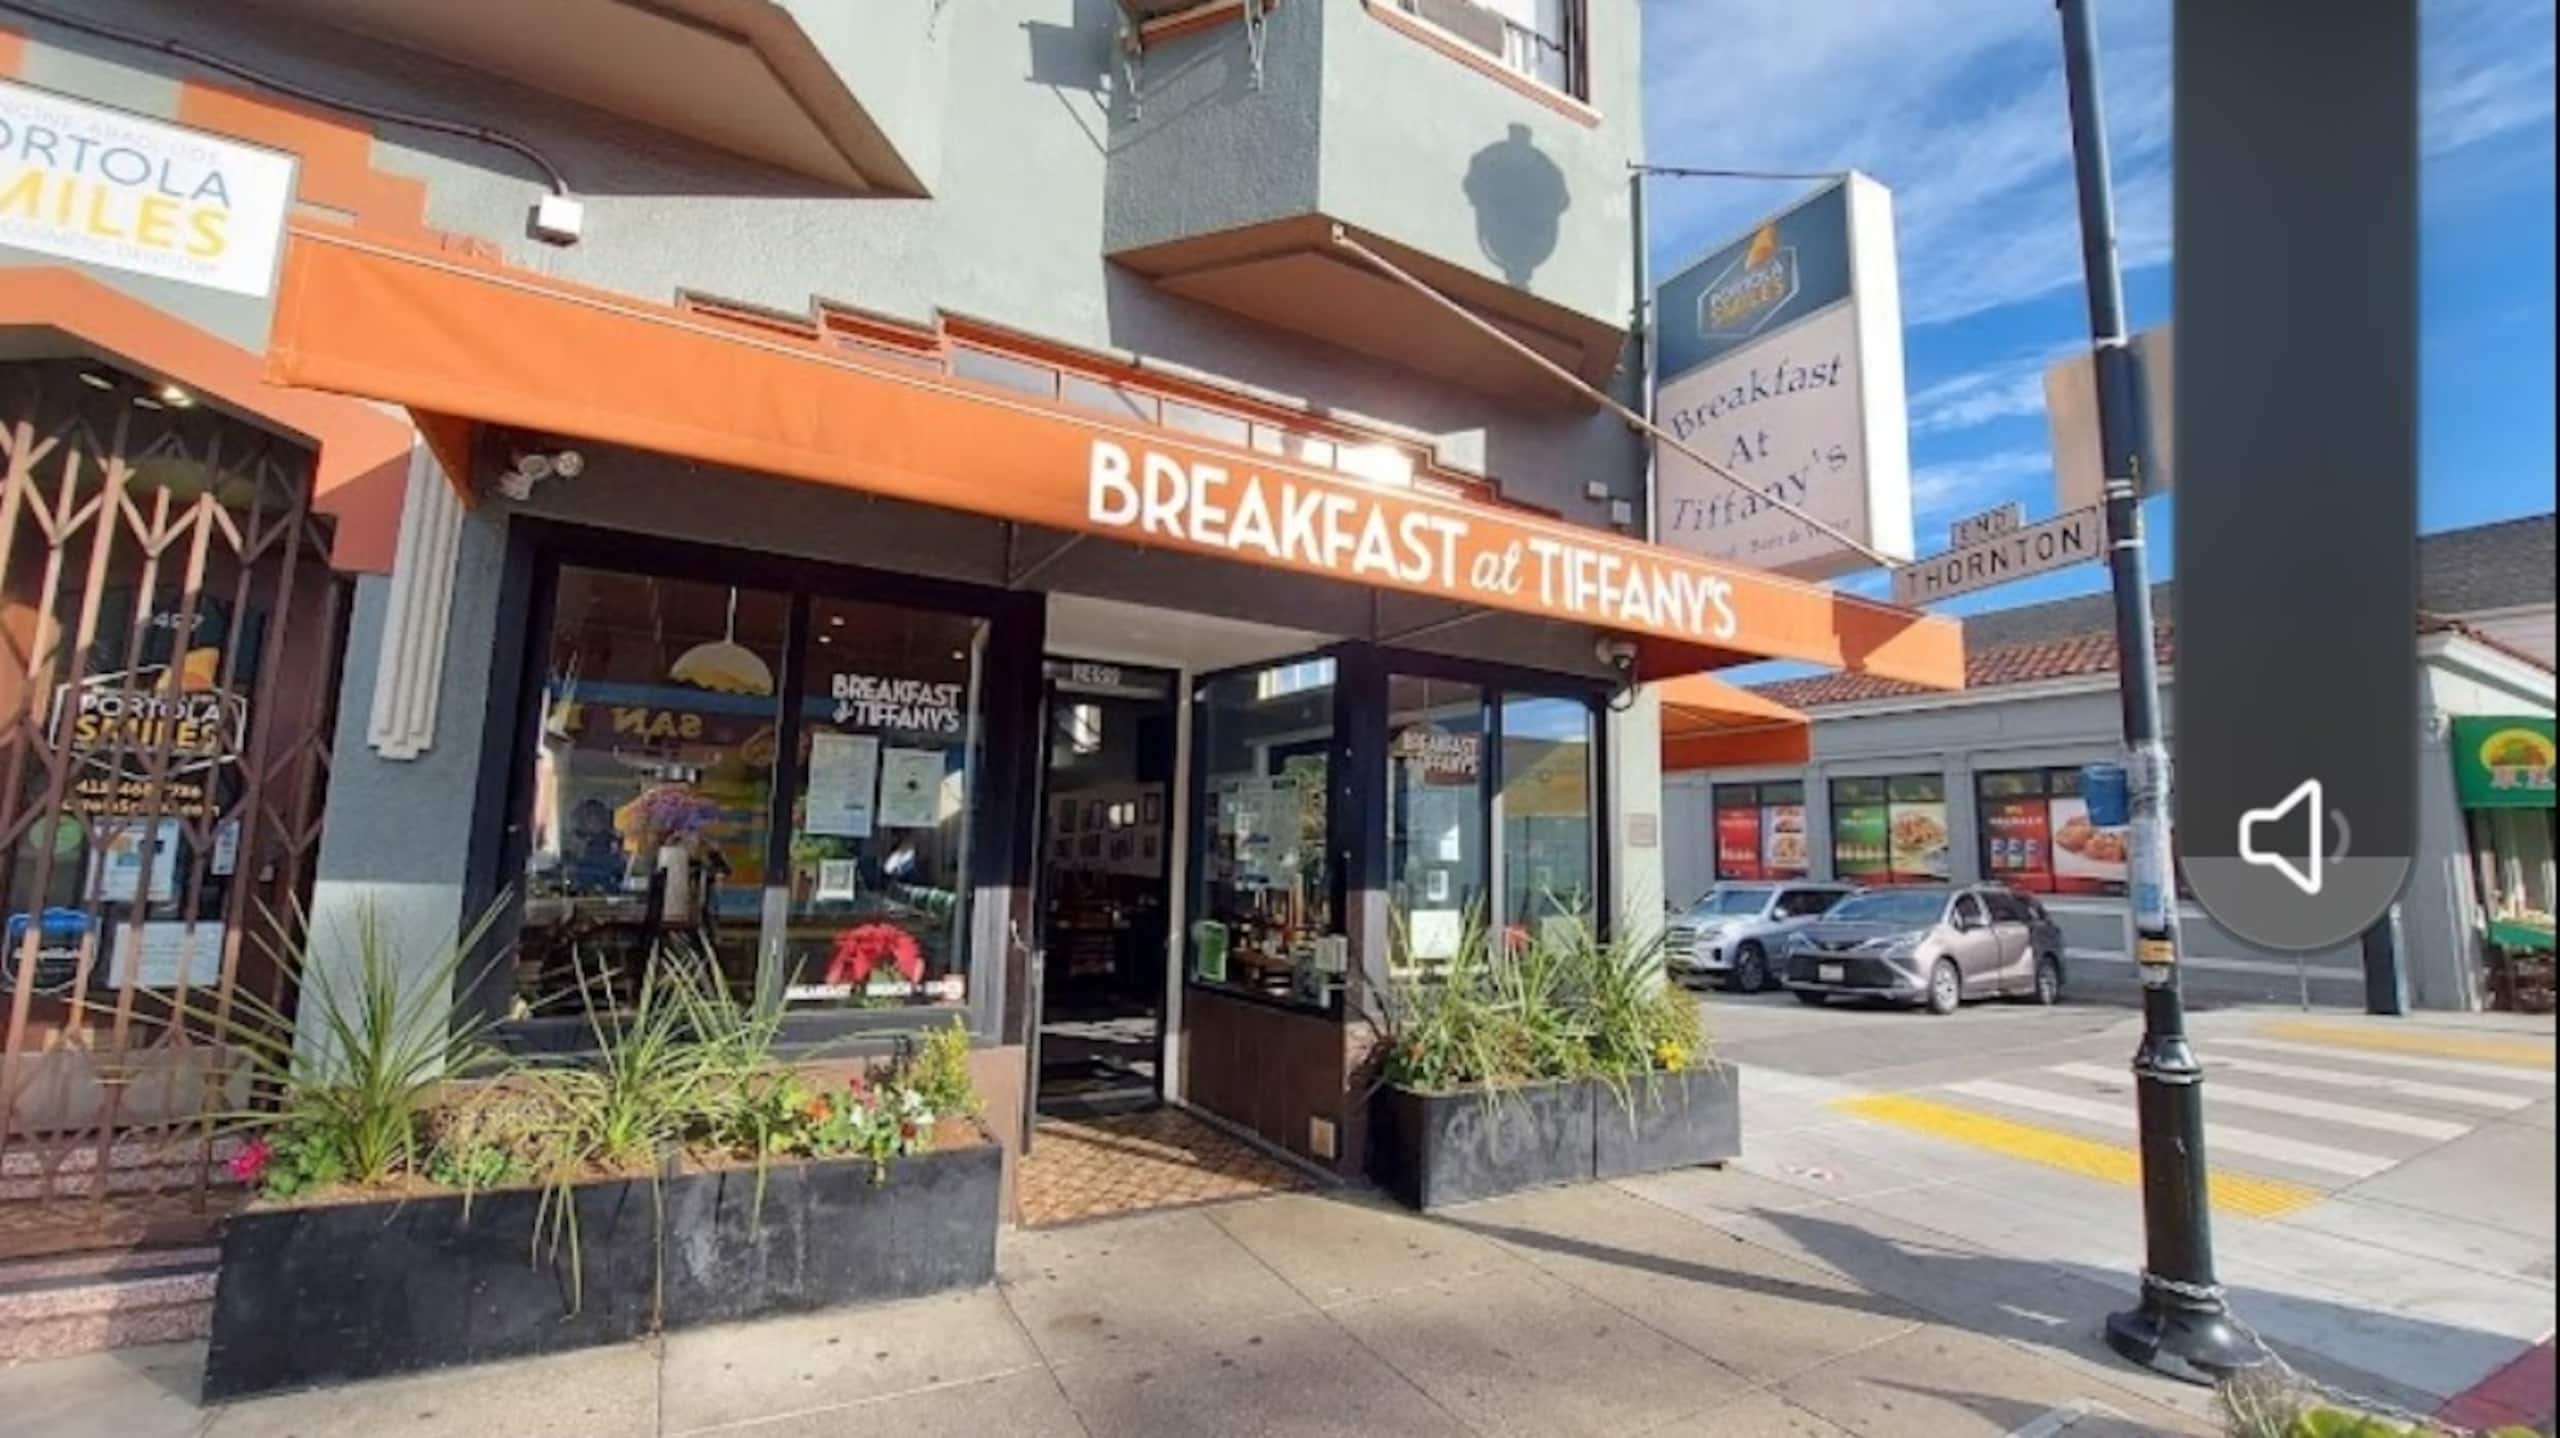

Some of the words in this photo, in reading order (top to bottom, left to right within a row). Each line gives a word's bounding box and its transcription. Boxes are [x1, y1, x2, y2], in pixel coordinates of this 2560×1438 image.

[1671, 352, 1843, 442] Breakfast
[1726, 428, 1772, 470] At
[1671, 442, 1849, 532] Tiffany's
[1087, 438, 1468, 589] BREAKFAST
[1470, 538, 1530, 596] at
[1527, 537, 1738, 641] TIFFANY'S
[1961, 508, 2008, 543] END
[1906, 519, 2083, 600] THORNTON
[832, 672, 963, 710] BREAKFAST
[853, 700, 961, 734] TIFFANY'S
